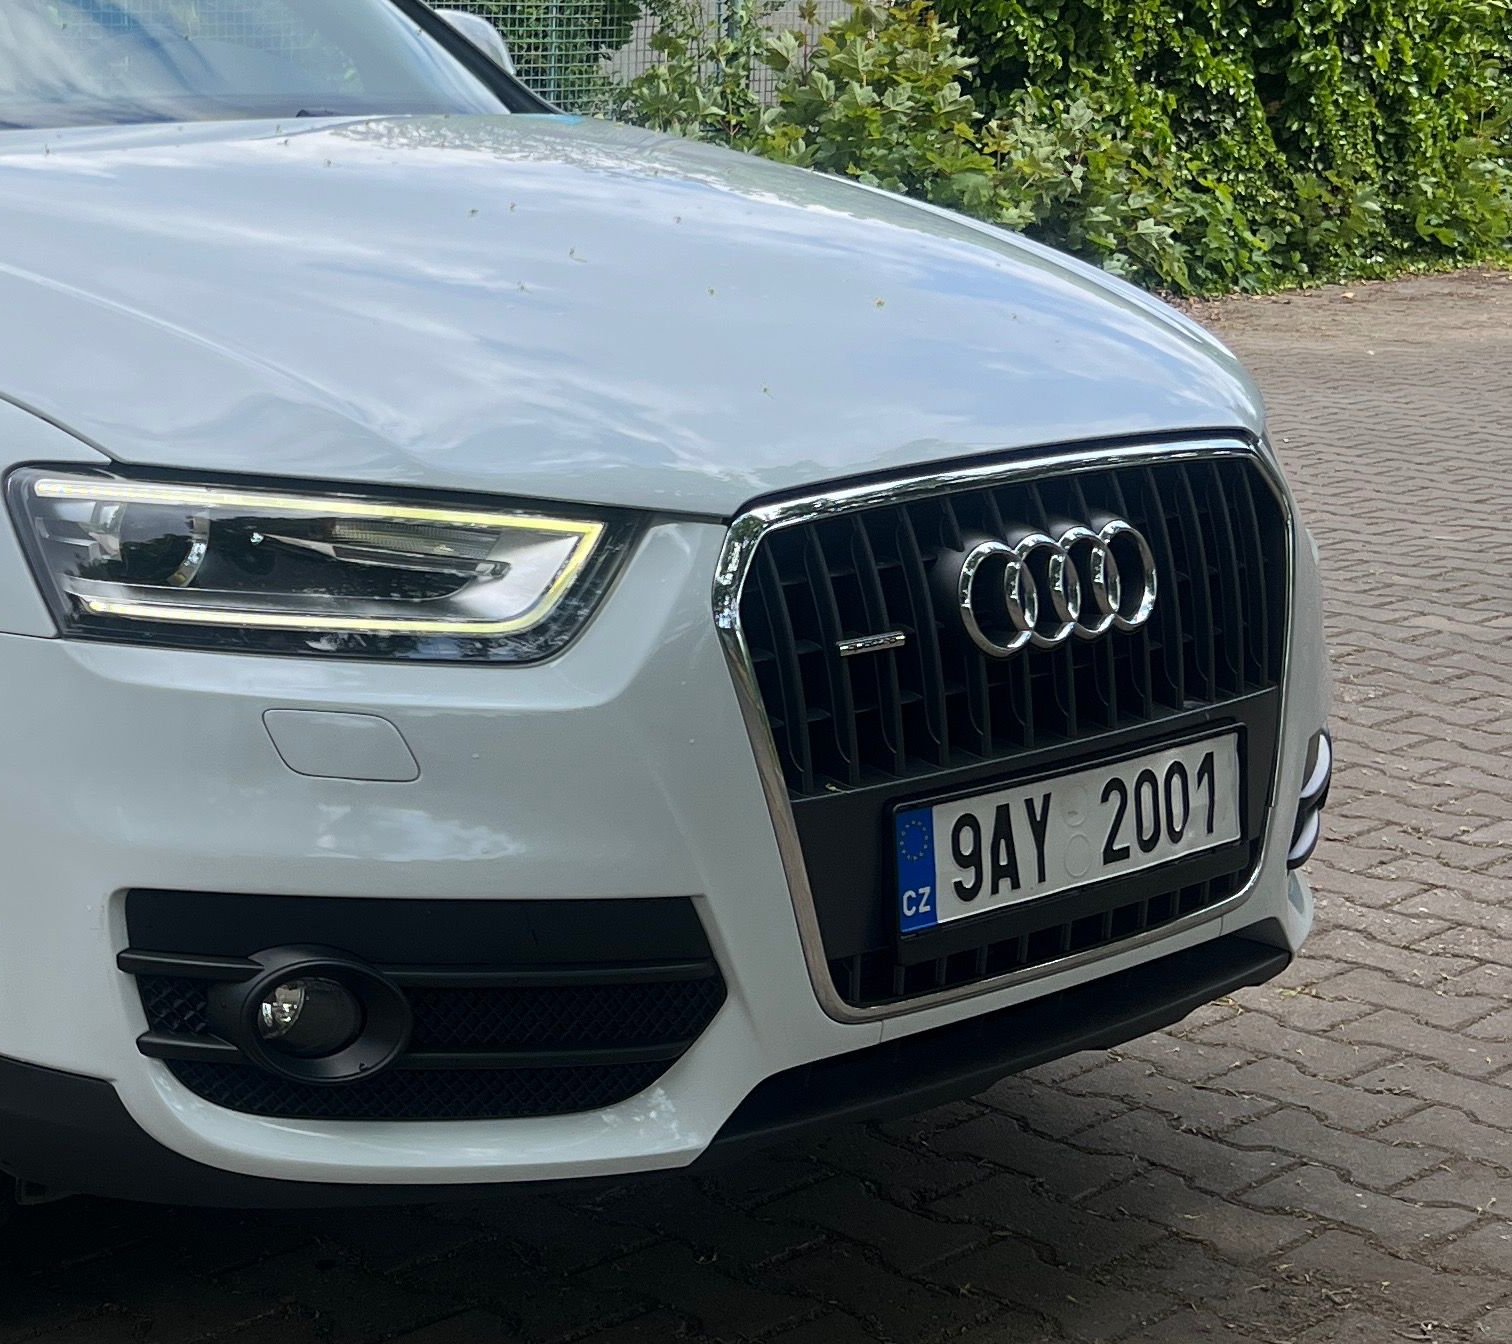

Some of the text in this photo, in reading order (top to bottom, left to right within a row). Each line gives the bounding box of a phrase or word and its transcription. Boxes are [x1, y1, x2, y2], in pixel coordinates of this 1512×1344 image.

[951, 751, 1215, 902] 9AY 2001
[902, 886, 931, 917] CZ
